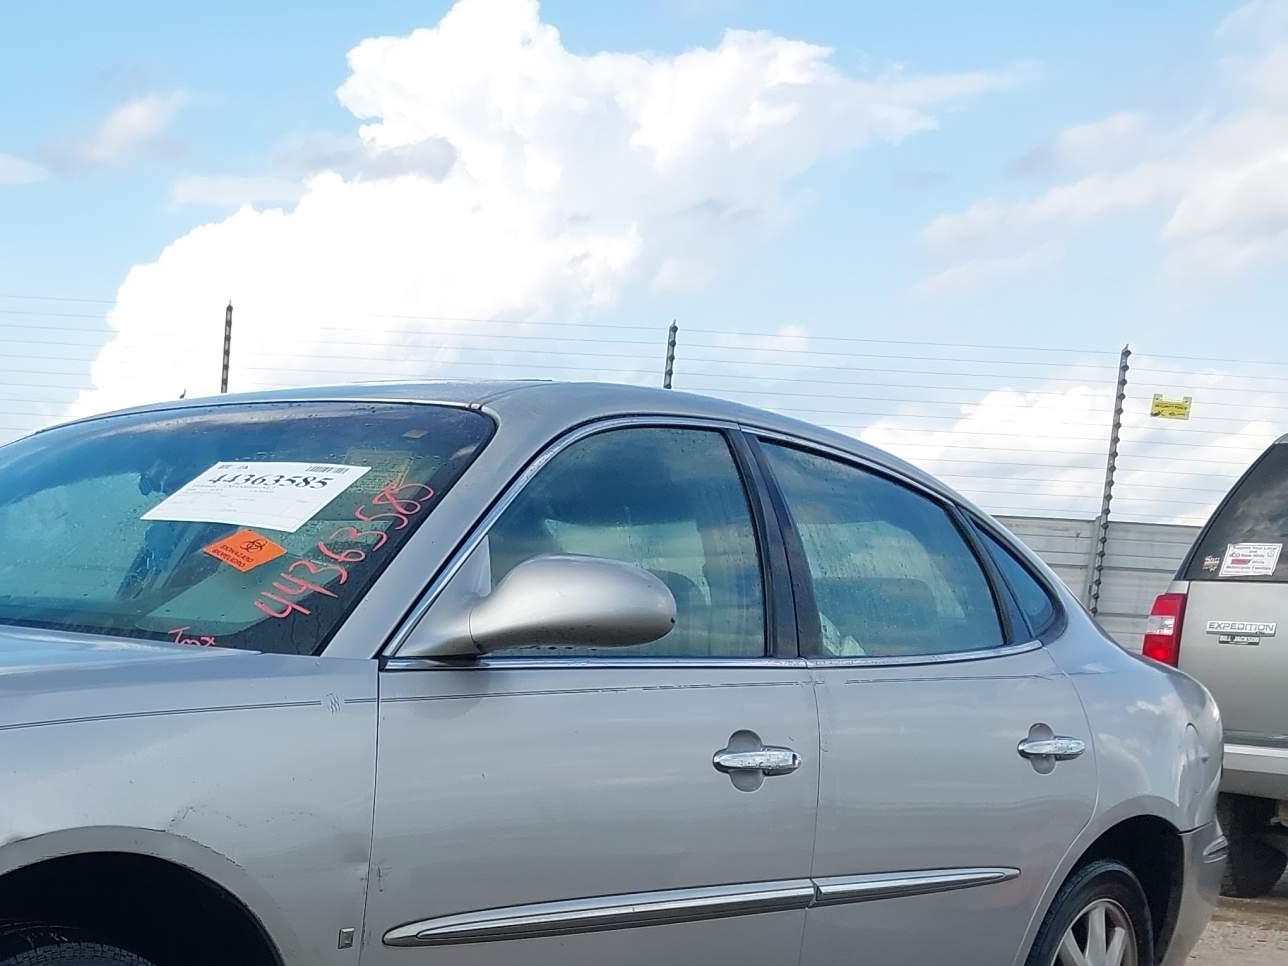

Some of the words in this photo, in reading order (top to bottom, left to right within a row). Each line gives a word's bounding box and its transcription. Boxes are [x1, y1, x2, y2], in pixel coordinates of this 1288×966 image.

[208, 473, 334, 489] 44363585
[254, 483, 434, 618] 44363585
[1208, 622, 1274, 632] EXPEDITION
